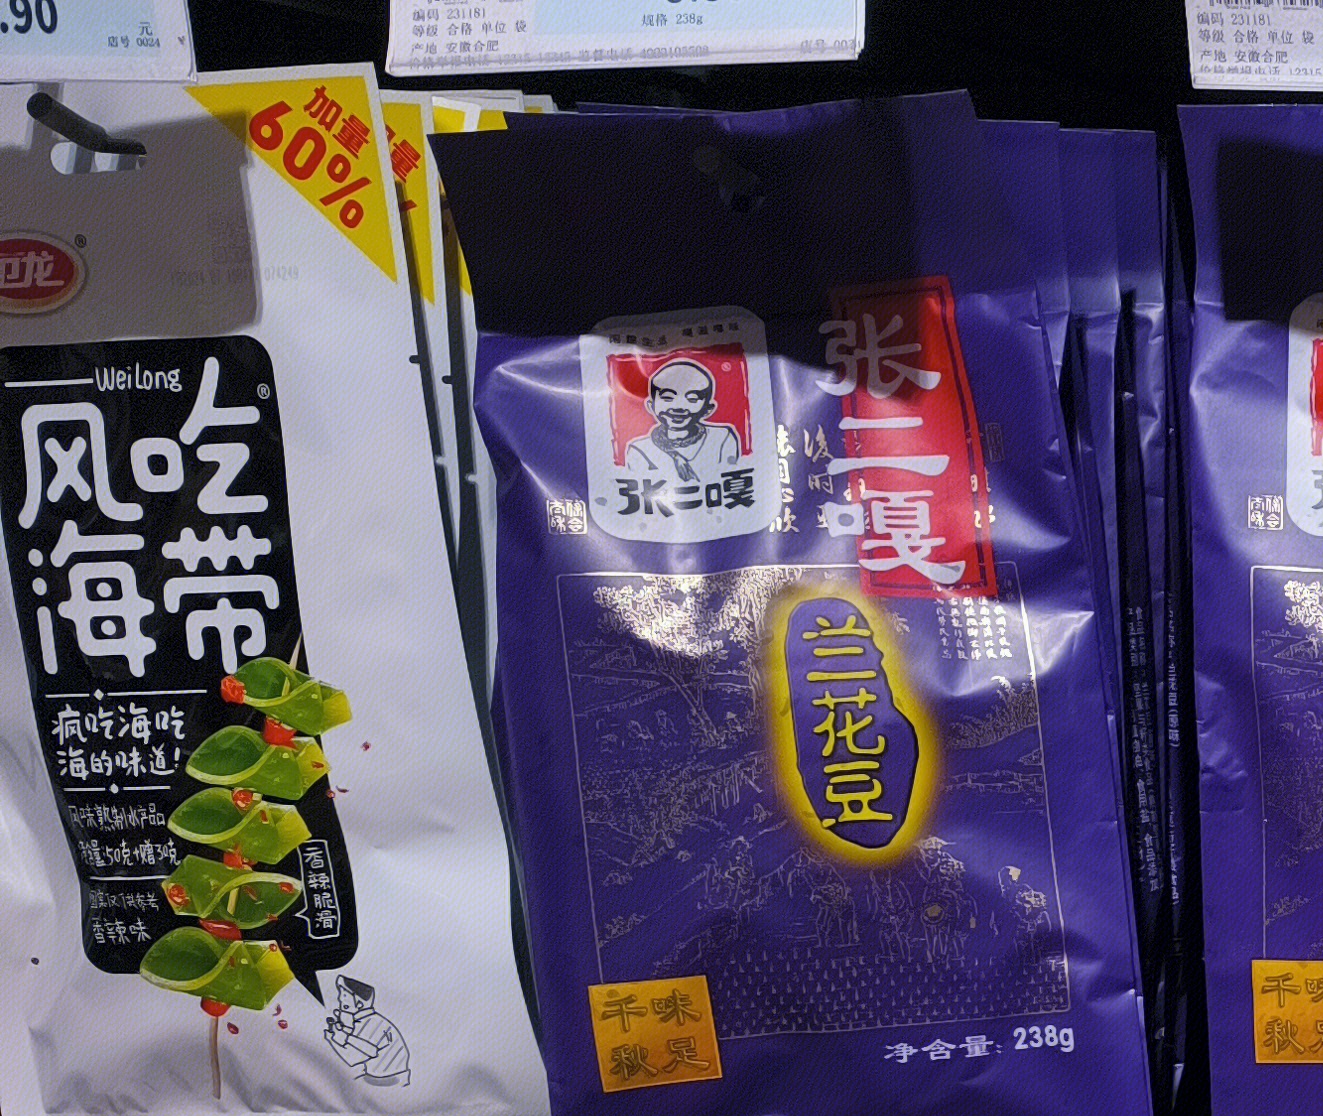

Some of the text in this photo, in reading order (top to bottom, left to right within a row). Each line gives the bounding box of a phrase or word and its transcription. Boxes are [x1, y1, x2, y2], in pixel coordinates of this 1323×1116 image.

[138, 21, 153, 36] 元
[675, 14, 703, 27] 238g
[136, 38, 160, 48] 0024
[446, 40, 499, 53] 安徽合肥
[1234, 50, 1289, 63] 安徽合肥
[304, 85, 371, 160] 加量
[249, 100, 372, 229] 60%
[95, 365, 182, 392] WeiLong
[18, 356, 268, 529] 风吃
[814, 312, 966, 584] 张二嘎
[615, 467, 756, 518] 张二嘎
[28, 519, 279, 677] 海带
[52, 702, 185, 745] 疯吃海吃
[802, 614, 893, 828] 兰花豆
[56, 746, 182, 781] 海的味道!
[92, 917, 152, 944] 香辣味
[884, 1024, 1075, 1063] 净含量: 238g
